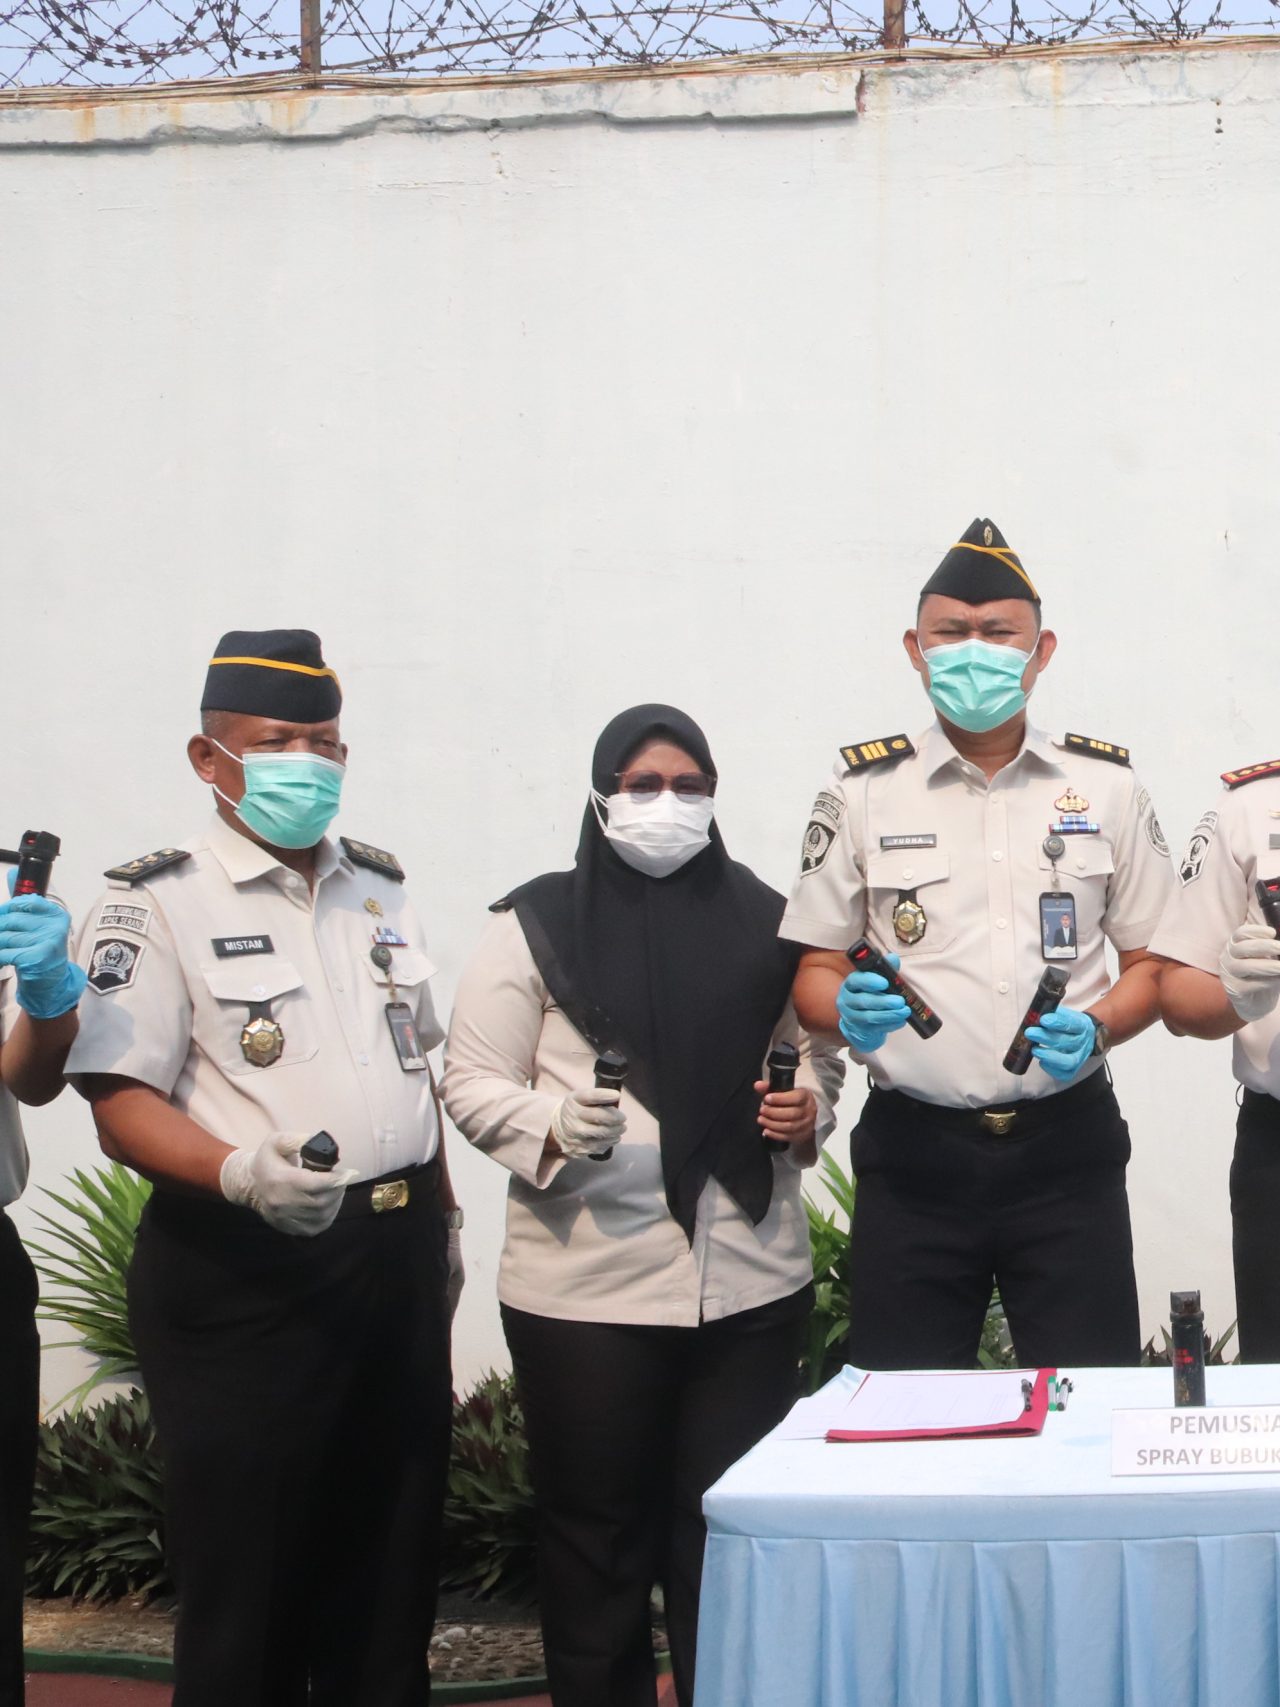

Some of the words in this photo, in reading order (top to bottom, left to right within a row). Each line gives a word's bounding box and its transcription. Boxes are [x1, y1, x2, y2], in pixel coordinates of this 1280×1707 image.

[892, 837, 923, 845] YUDHA
[224, 939, 264, 951] MISTAM
[1137, 1448, 1203, 1466] SPRAY
